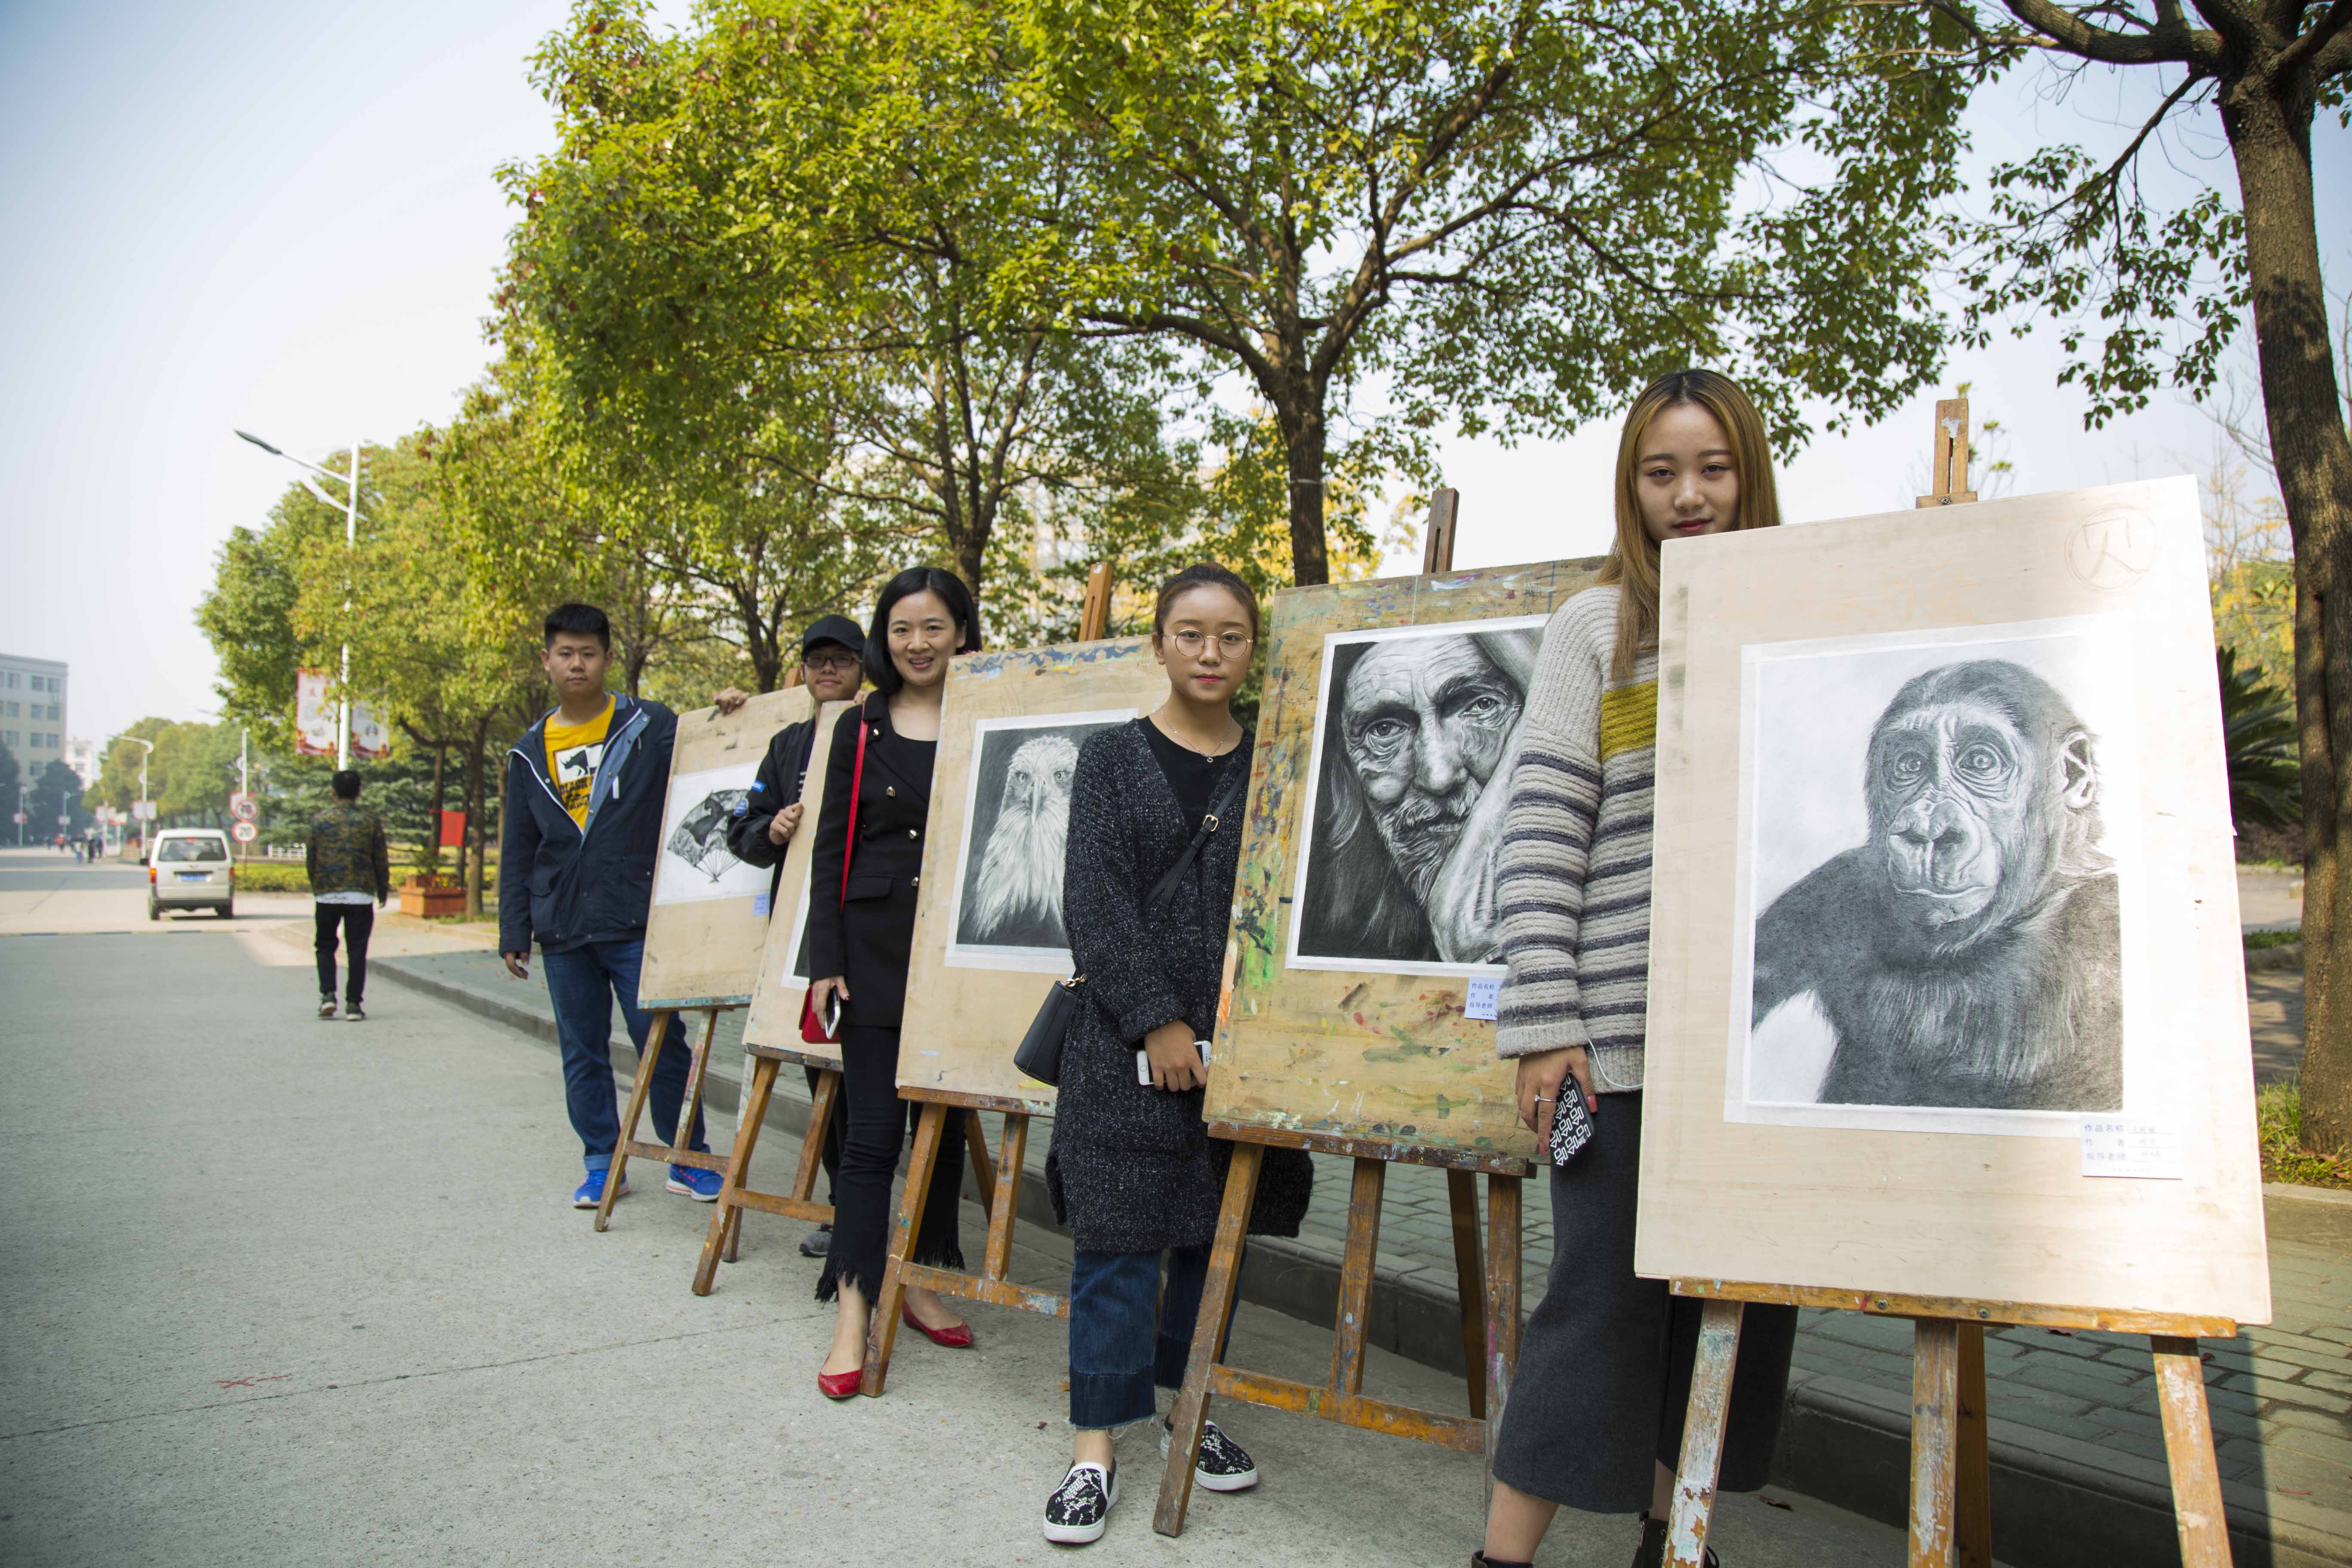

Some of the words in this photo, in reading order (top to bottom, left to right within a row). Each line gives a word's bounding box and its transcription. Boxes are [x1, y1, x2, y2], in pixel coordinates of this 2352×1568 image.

[239, 827, 252, 836] 20
[2084, 1124, 2125, 1132] 作品名称
